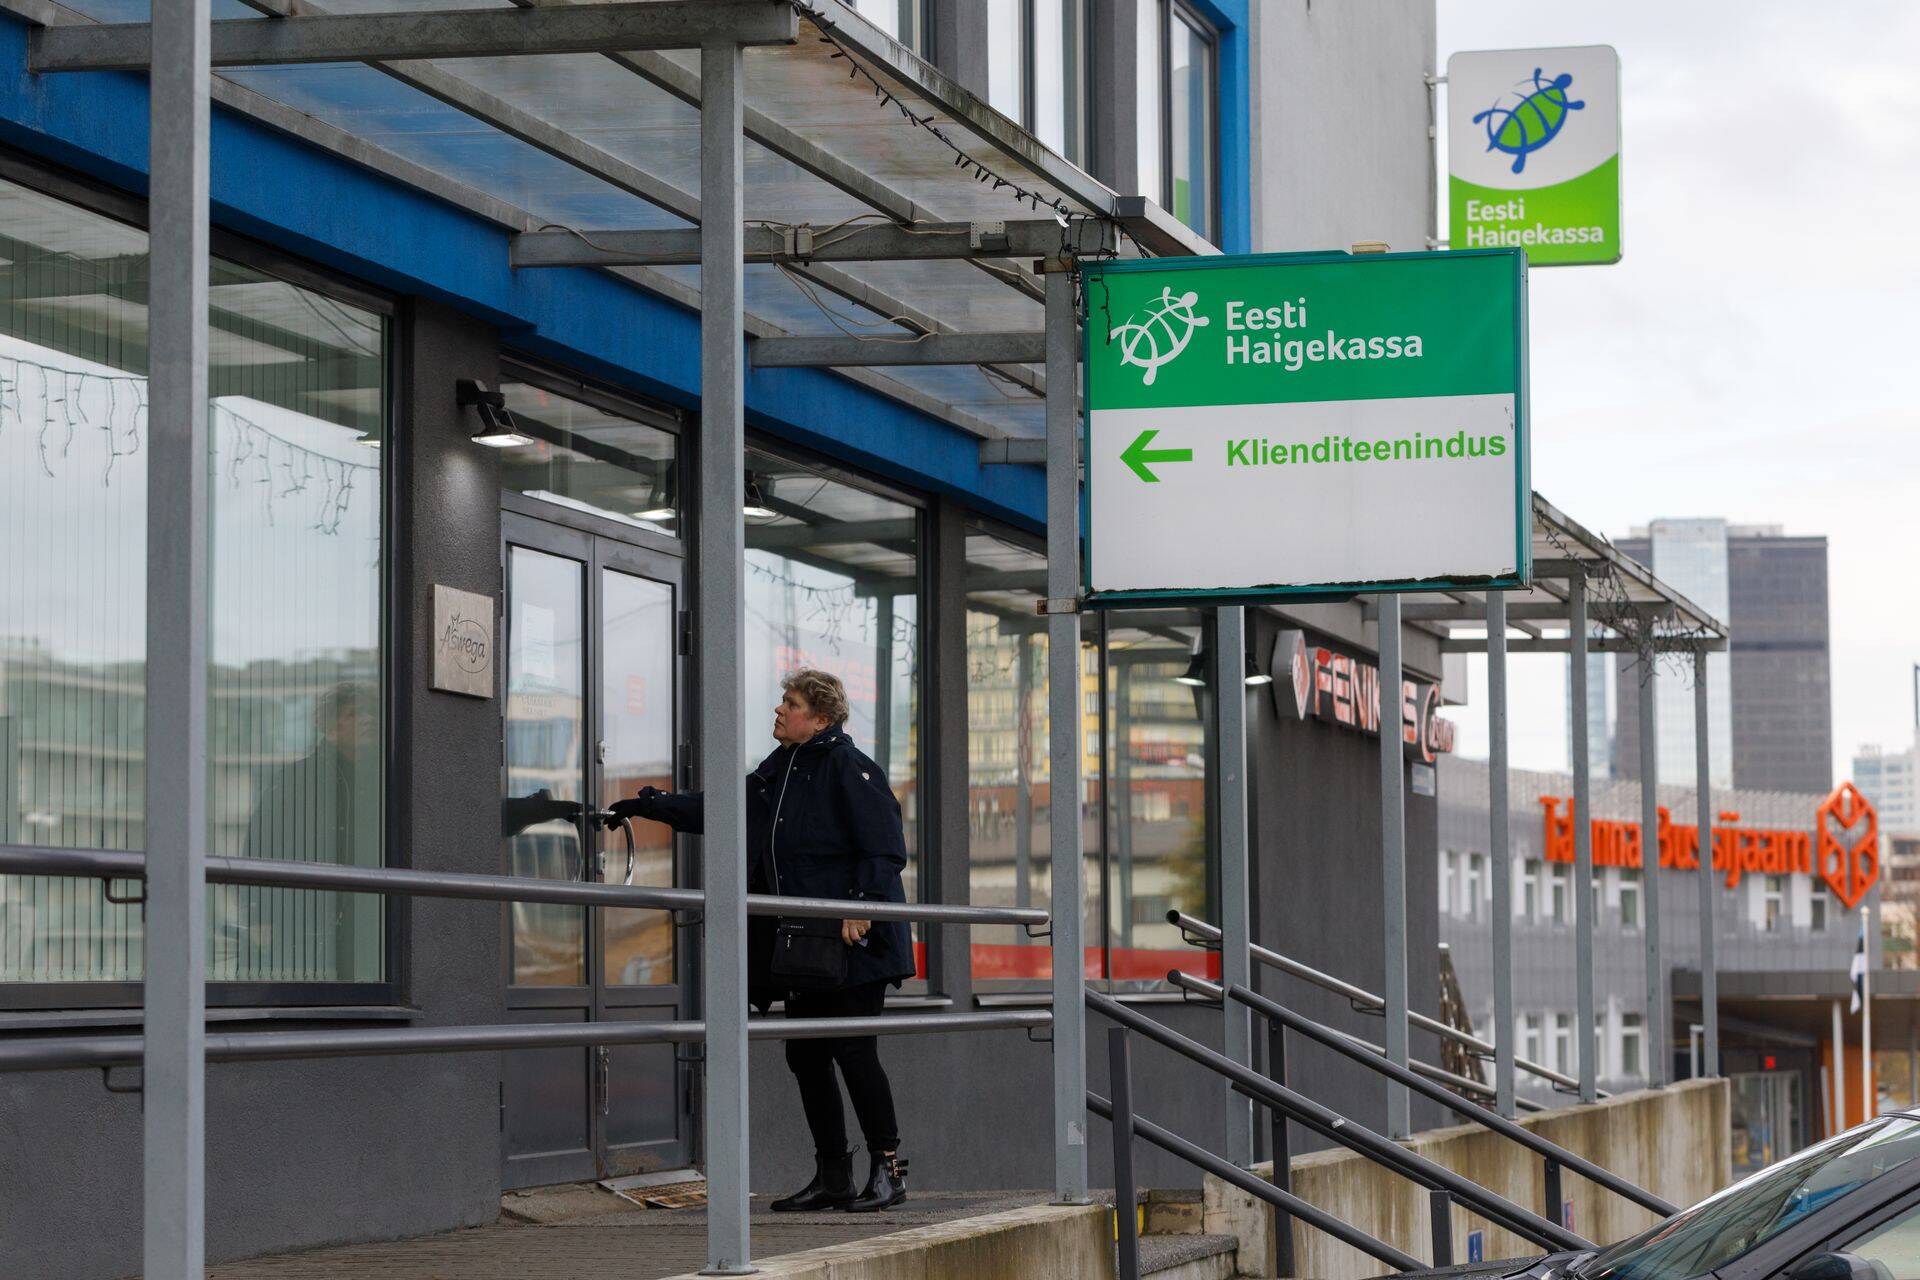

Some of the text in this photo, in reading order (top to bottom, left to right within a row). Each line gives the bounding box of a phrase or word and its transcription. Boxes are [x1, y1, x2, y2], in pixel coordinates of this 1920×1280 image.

[1466, 198, 1525, 222] Eesti
[1466, 222, 1604, 247] Haigekassa
[1226, 297, 1307, 331] Eesti
[1226, 330, 1424, 371] Haigekassa
[1226, 431, 1506, 467] Klienditeenindus
[1314, 647, 1418, 745] FENIKS
